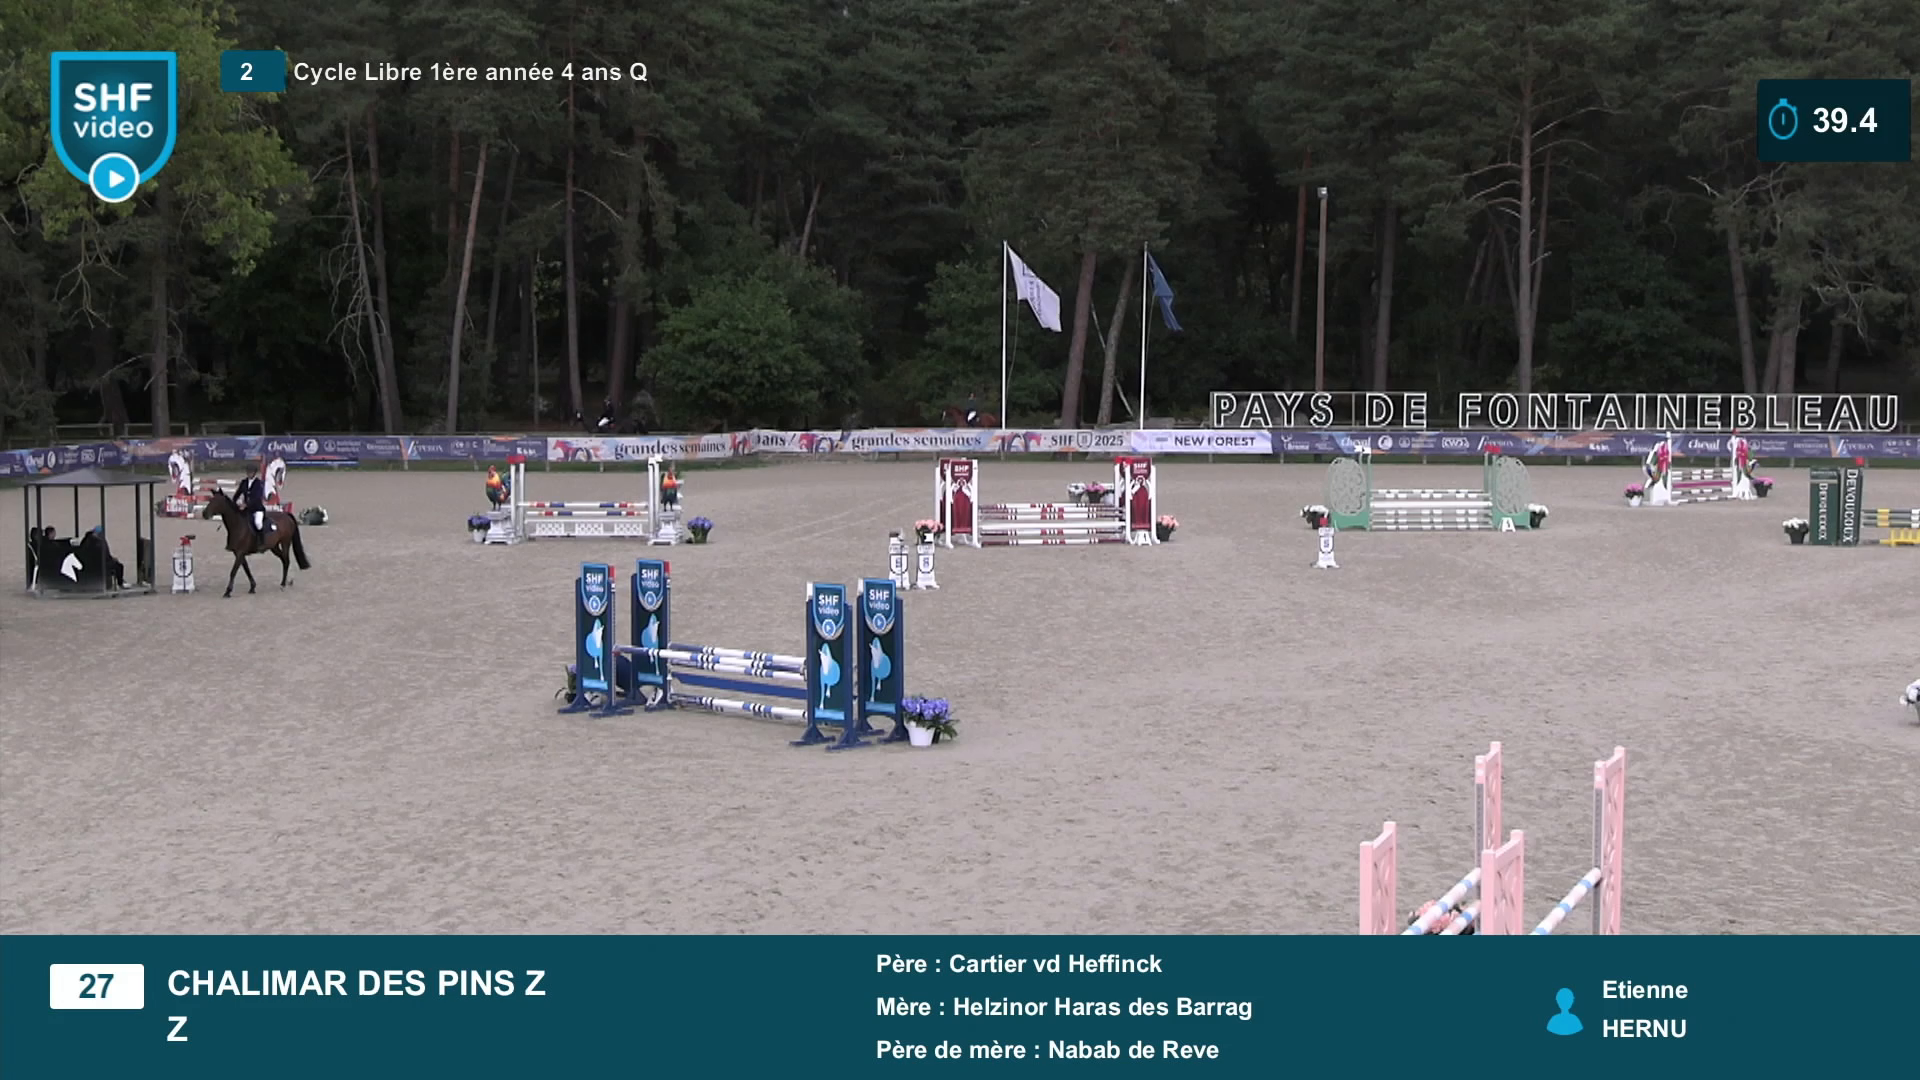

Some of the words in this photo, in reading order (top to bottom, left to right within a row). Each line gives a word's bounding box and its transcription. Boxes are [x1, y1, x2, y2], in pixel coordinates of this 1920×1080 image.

[1213, 392, 1334, 428] PAYS
[1365, 392, 1427, 428] DE
[1459, 393, 1898, 431] FONTAINEBLEAU
[852, 432, 910, 450] grandes
[913, 433, 982, 446] semaines
[1094, 434, 1124, 446] 2025
[1174, 436, 1205, 447] NEW
[1207, 436, 1256, 447] FOREST
[614, 440, 677, 460] grandes
[679, 441, 726, 452] semaines
[1842, 469, 1859, 543] DEVOUCOUX
[642, 569, 660, 580] SHF
[818, 594, 840, 606] SHF
[869, 589, 890, 601] SHF
[869, 601, 890, 611] video
